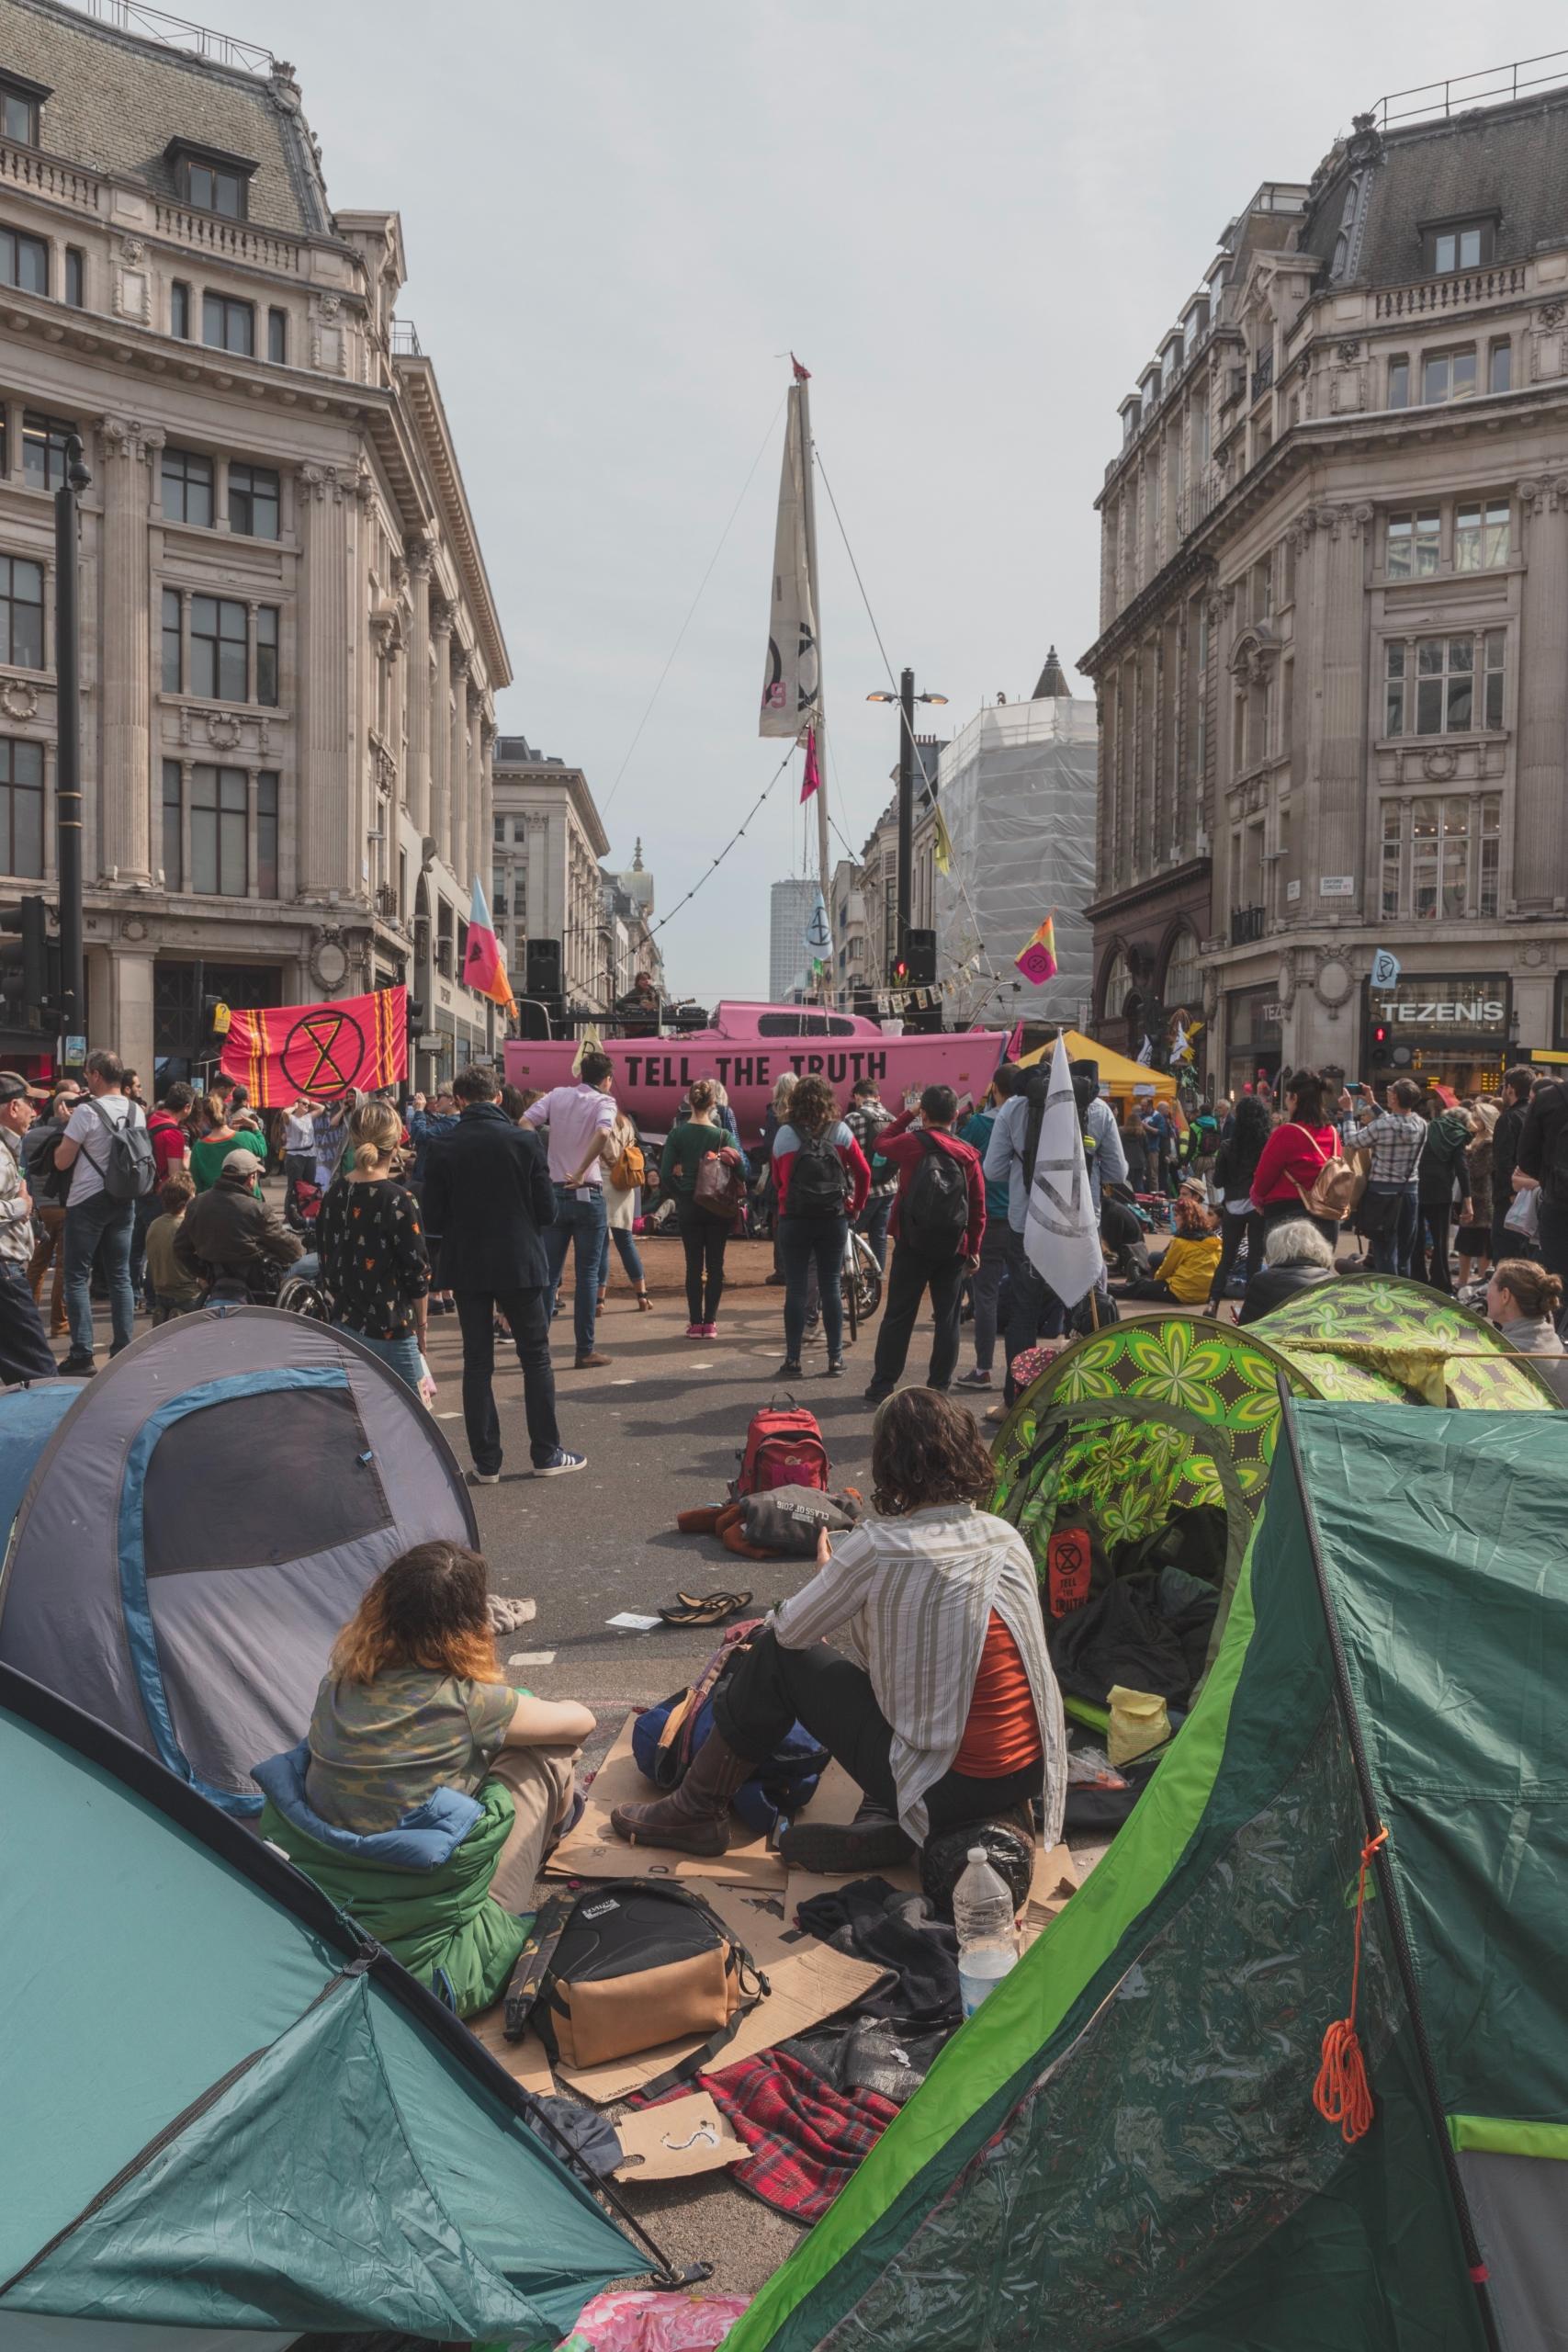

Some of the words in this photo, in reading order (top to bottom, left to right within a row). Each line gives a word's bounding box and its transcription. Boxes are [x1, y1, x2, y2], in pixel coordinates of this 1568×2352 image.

[625, 1057, 694, 1086] TELL
[716, 1057, 770, 1086] THE
[790, 1051, 886, 1083] TRUTH
[776, 1500, 795, 1511] 2016
[795, 1505, 805, 1514] OF
[805, 1507, 829, 1521] CLASS
